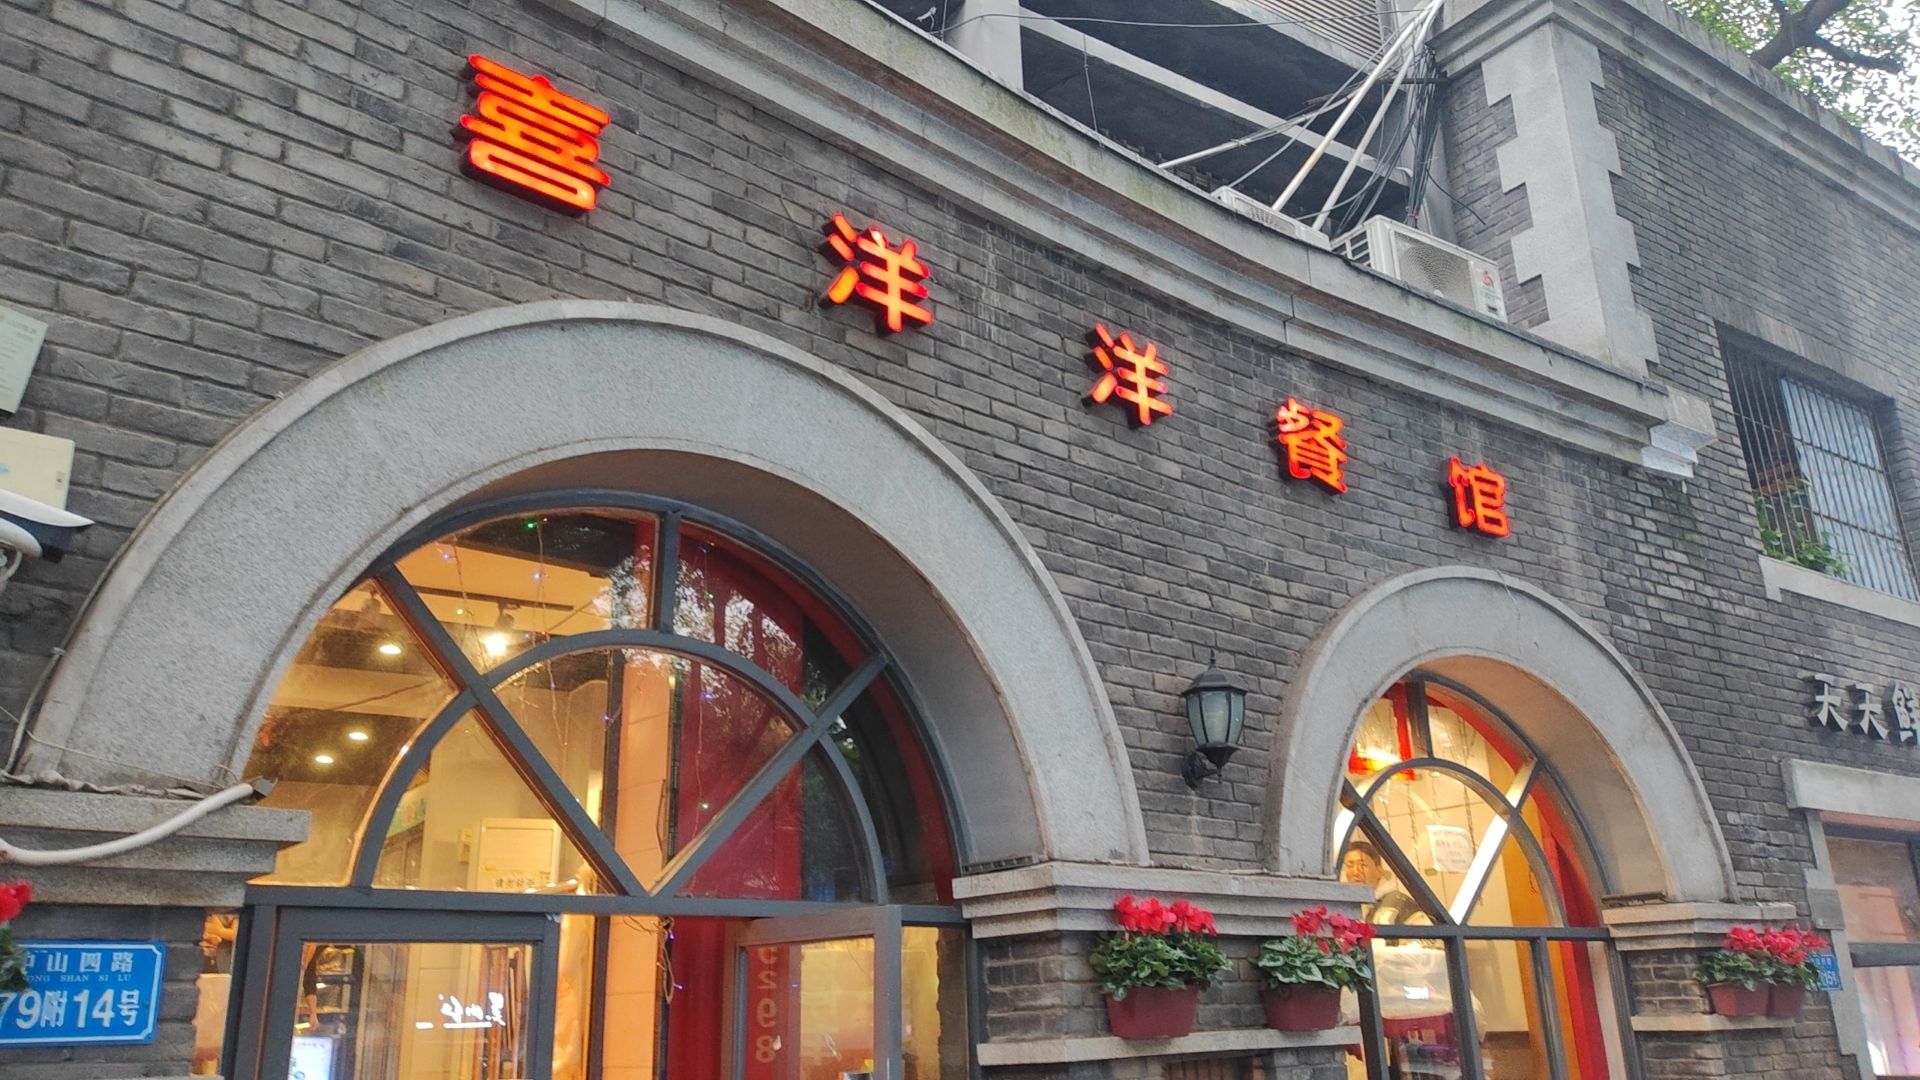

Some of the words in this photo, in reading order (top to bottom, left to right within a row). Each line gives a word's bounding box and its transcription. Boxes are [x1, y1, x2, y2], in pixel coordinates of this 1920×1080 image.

[460, 54, 1511, 538] 喜洋洋餐馆
[60, 974, 89, 982] SHAN
[98, 974, 109, 982] SI
[118, 974, 132, 982] LU
